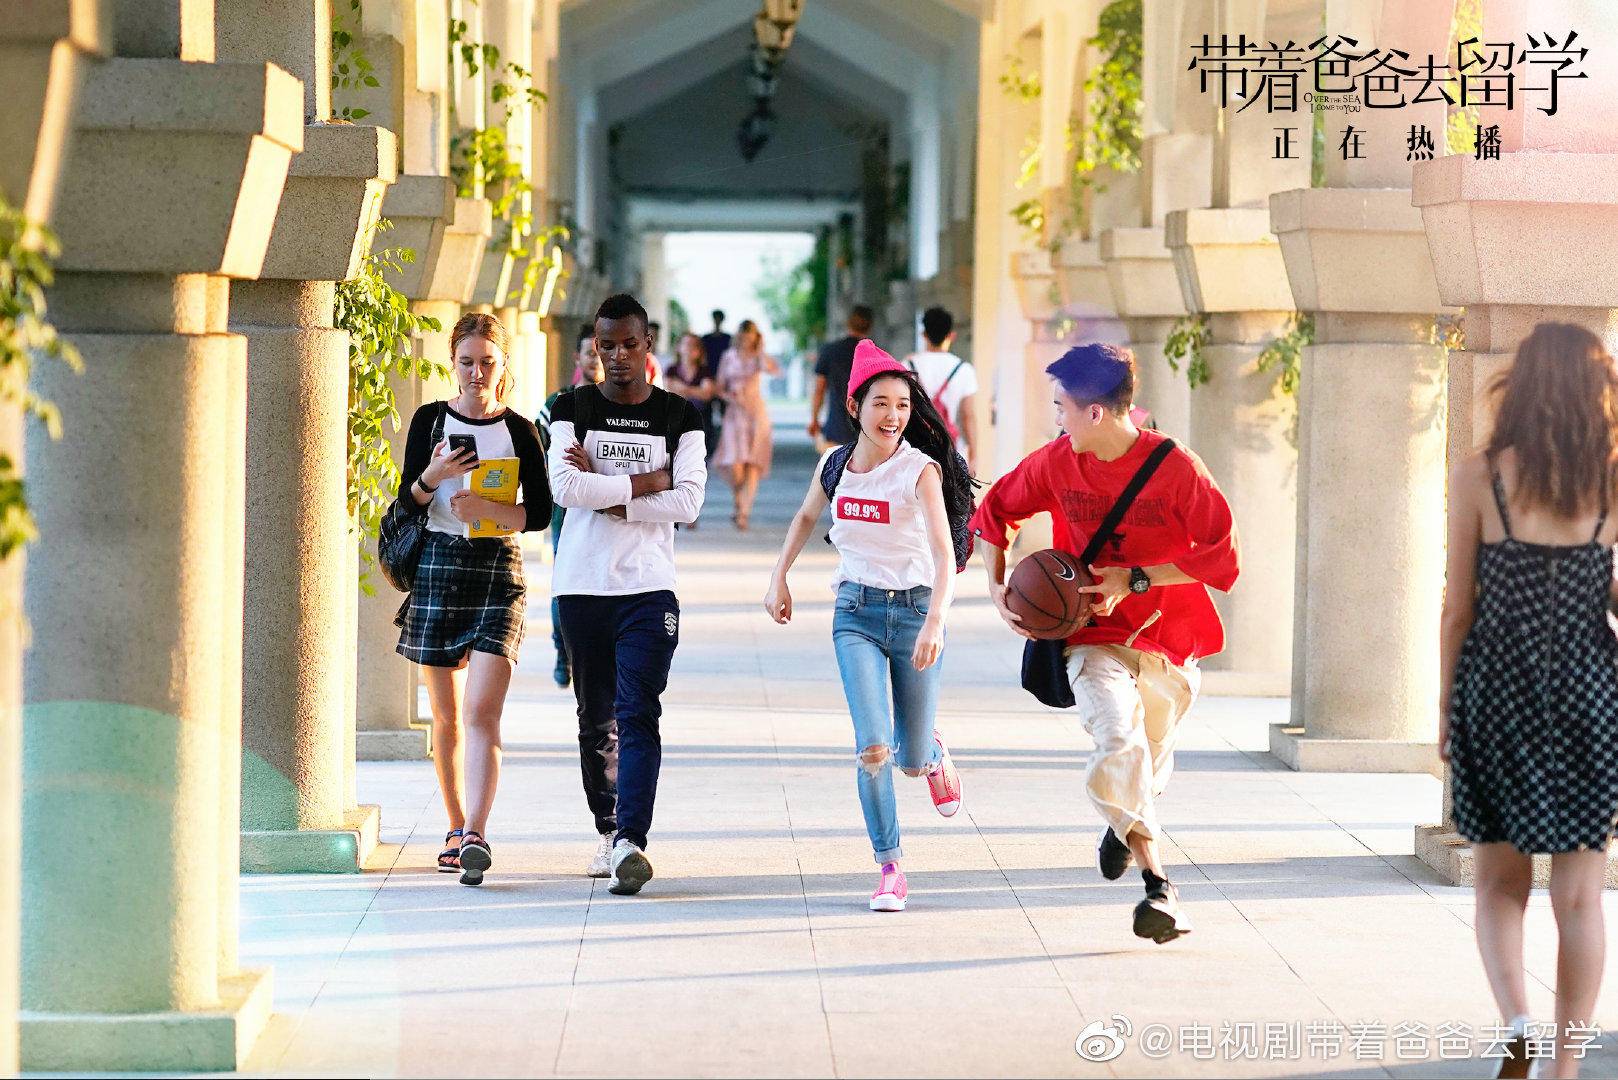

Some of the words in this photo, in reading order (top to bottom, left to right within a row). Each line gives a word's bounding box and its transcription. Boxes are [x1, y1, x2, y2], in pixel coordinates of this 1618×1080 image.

[602, 444, 646, 460] BANANA
[614, 461, 631, 469] SPLIT
[843, 501, 881, 520] 99.9%
